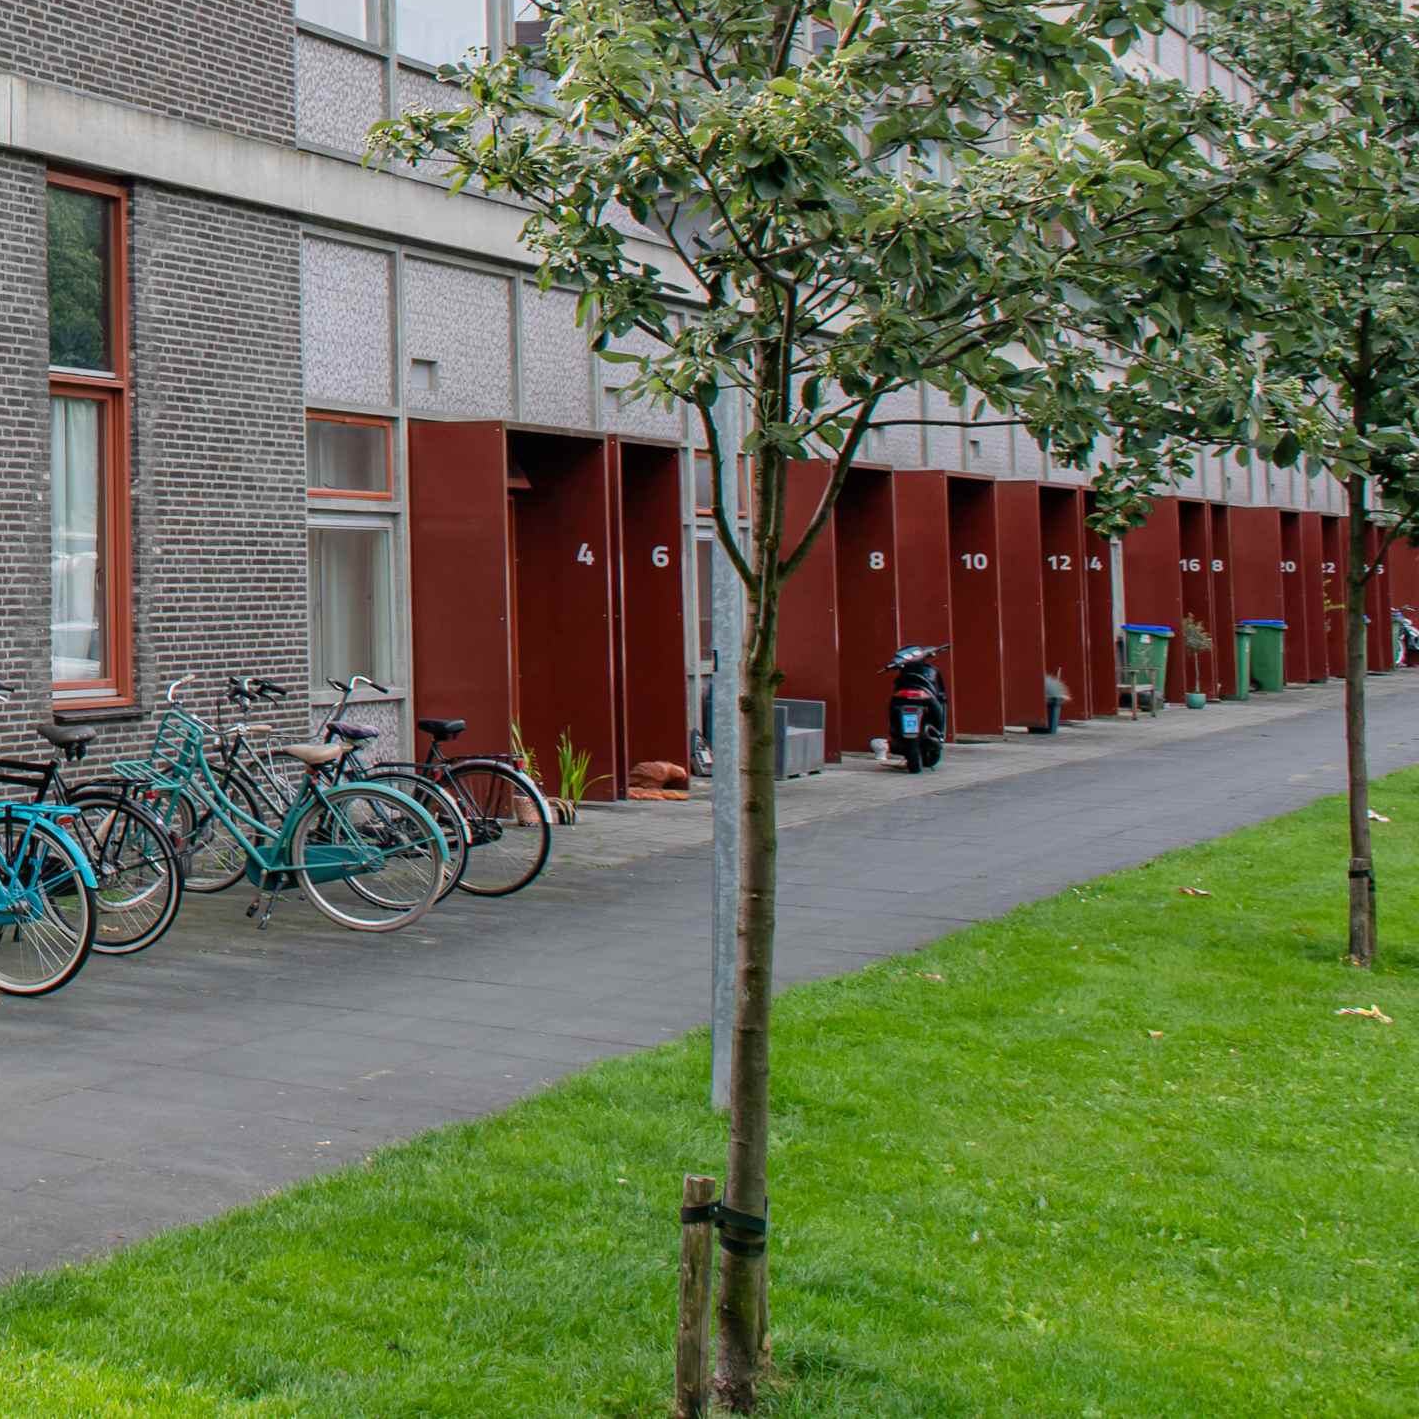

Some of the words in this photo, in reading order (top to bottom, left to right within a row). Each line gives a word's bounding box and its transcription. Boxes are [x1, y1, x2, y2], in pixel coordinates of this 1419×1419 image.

[577, 543, 595, 566] 4
[652, 545, 669, 567] 6
[869, 551, 885, 570] 8
[961, 553, 988, 570] 10
[1048, 555, 1072, 571] 12
[1179, 559, 1201, 572] 16
[1211, 559, 1224, 572] 8
